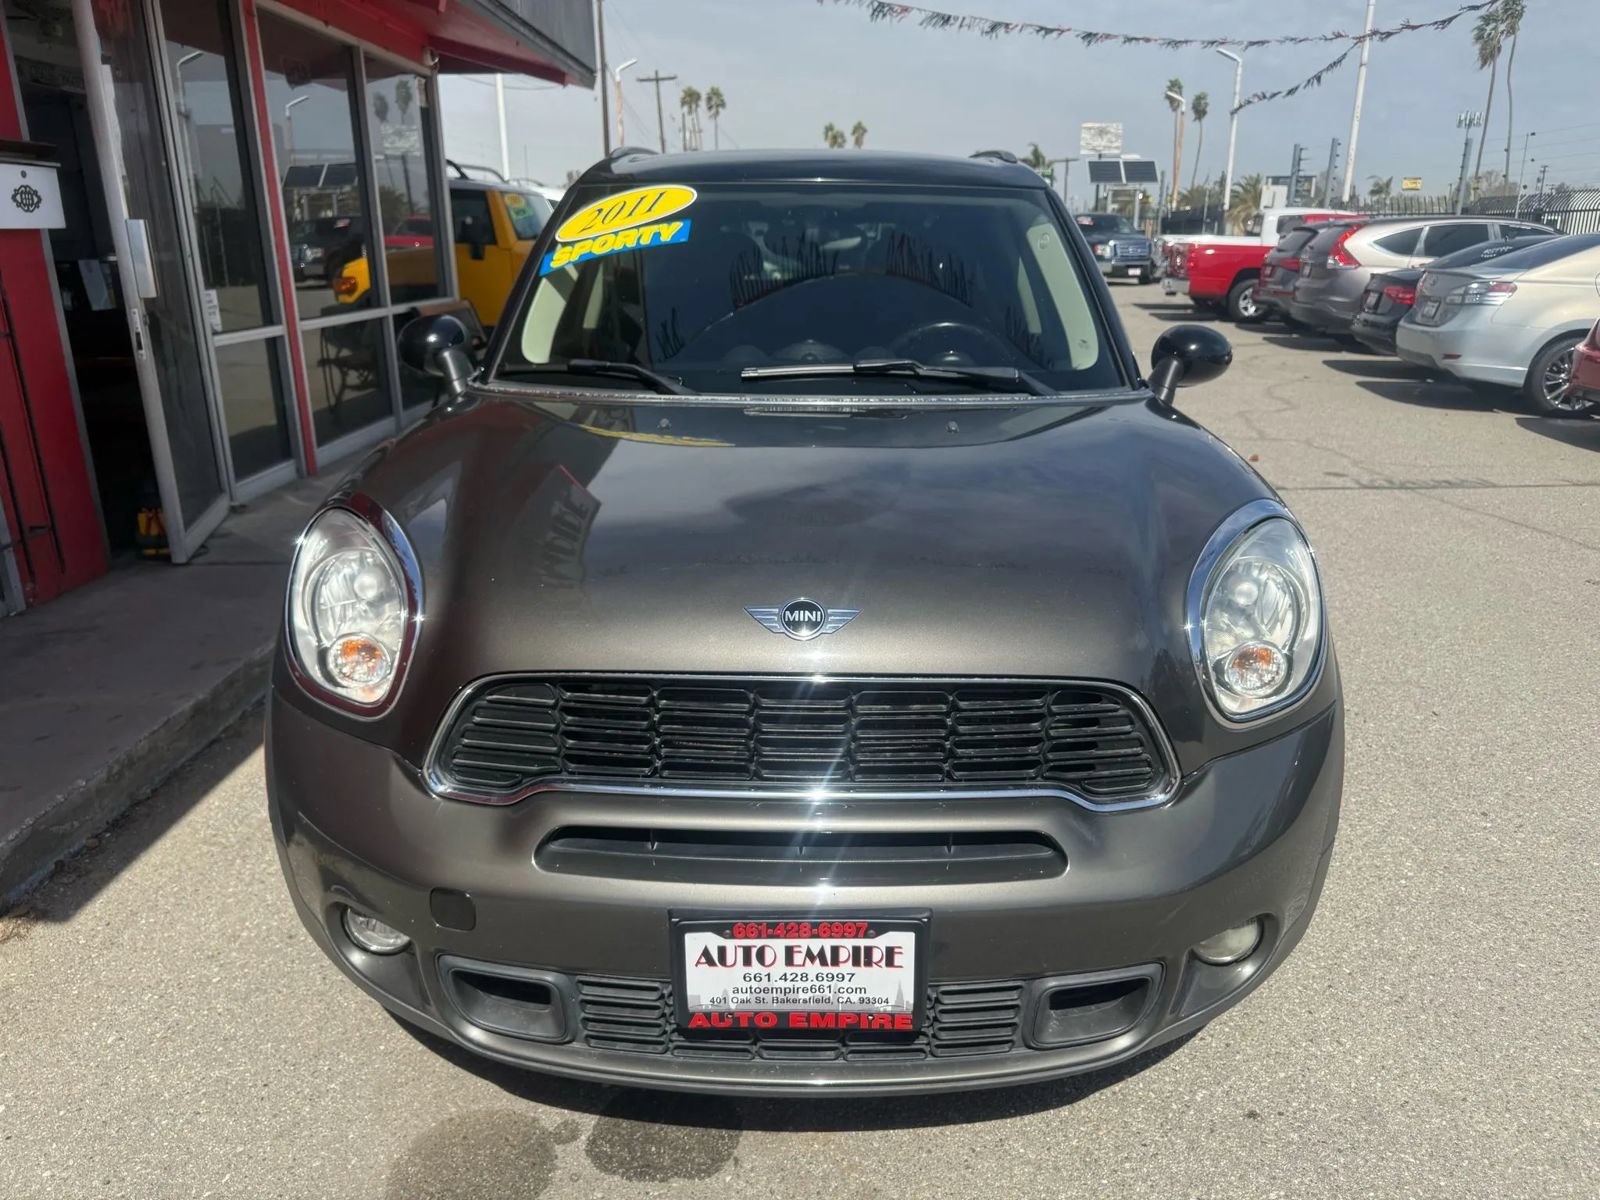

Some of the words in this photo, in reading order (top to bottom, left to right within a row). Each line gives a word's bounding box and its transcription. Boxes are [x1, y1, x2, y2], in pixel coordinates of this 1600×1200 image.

[578, 191, 667, 233] 2011
[550, 222, 683, 267] SPORTY
[785, 610, 821, 622] MINI
[733, 922, 869, 939] 661-428-6997
[695, 944, 777, 968] AUTO
[784, 945, 904, 968] EMPIRE
[743, 972, 856, 983] 661.428.6997
[732, 983, 867, 996] autoempire661.com
[709, 996, 728, 1005] 401
[731, 996, 752, 1005] Oak
[754, 996, 769, 1005] St.
[772, 996, 834, 1006] Bakersfield,
[858, 997, 889, 1005] 93304
[688, 1011, 777, 1028] AUTO
[789, 1012, 913, 1030] EMPIRE
